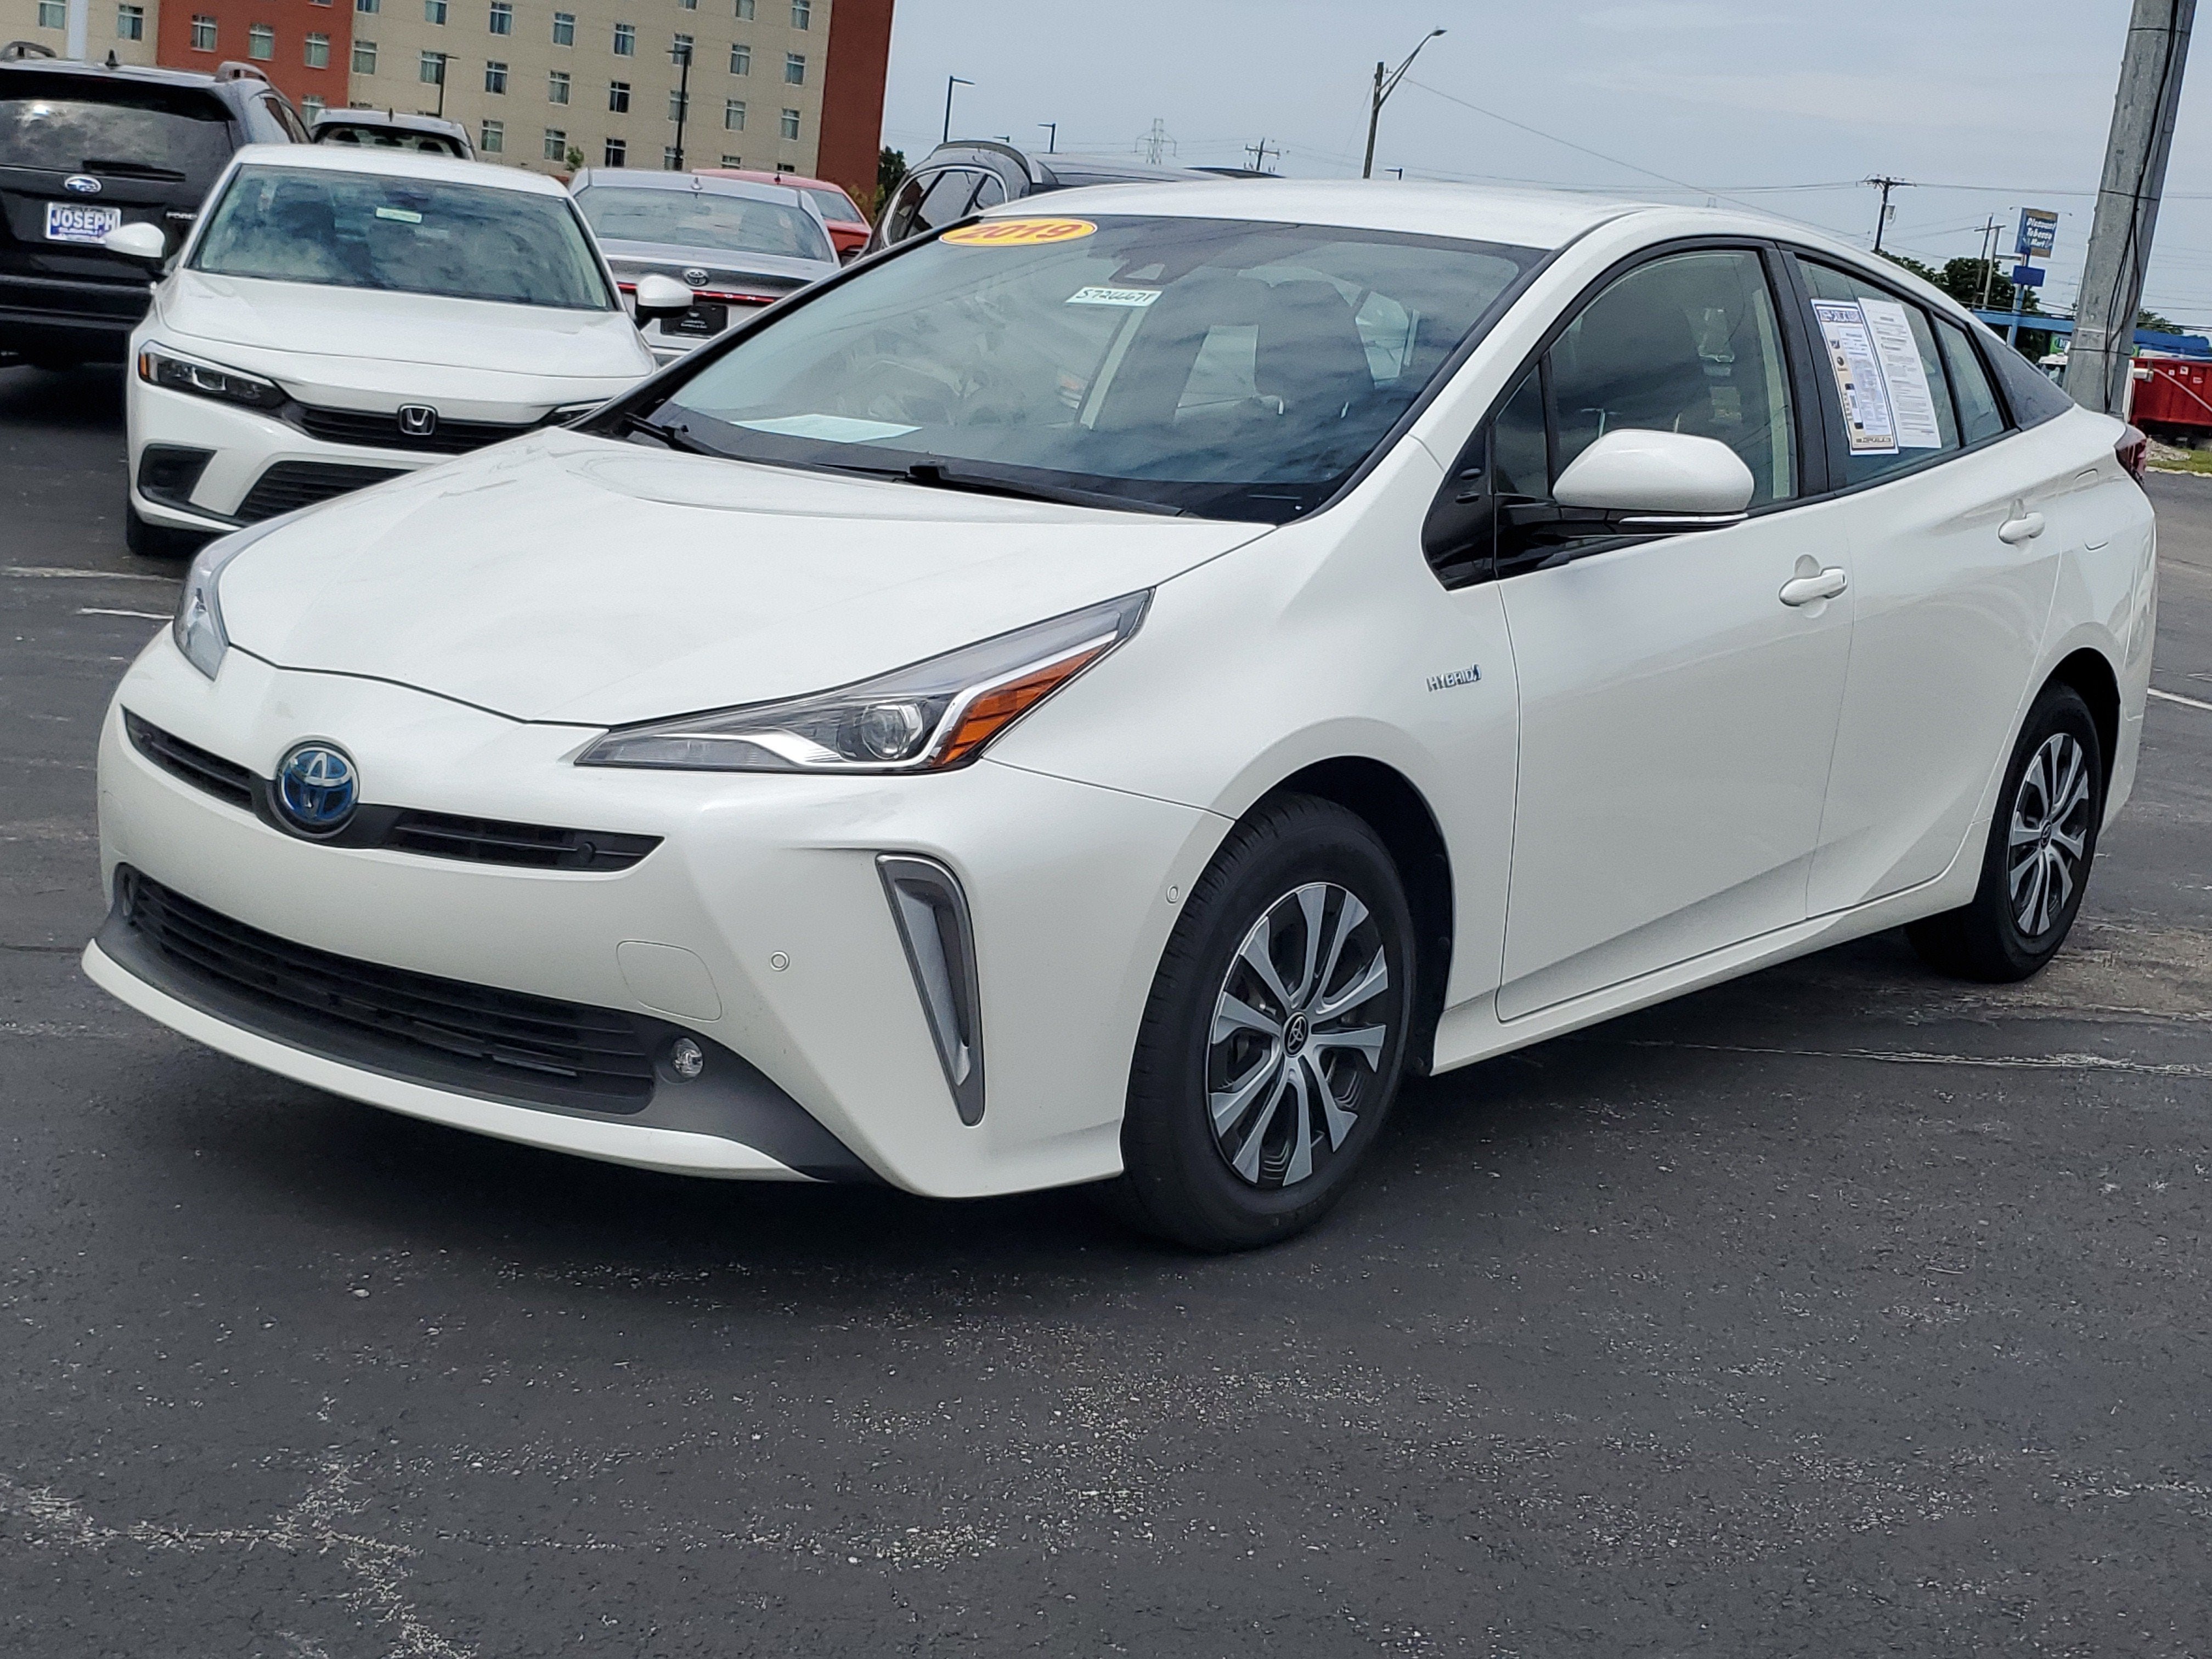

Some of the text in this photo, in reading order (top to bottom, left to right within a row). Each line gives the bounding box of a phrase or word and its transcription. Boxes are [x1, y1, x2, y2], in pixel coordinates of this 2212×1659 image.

[52, 209, 116, 231] JOSEPH
[951, 224, 1082, 240] 2019
[1426, 668, 1474, 692] HYBRID
